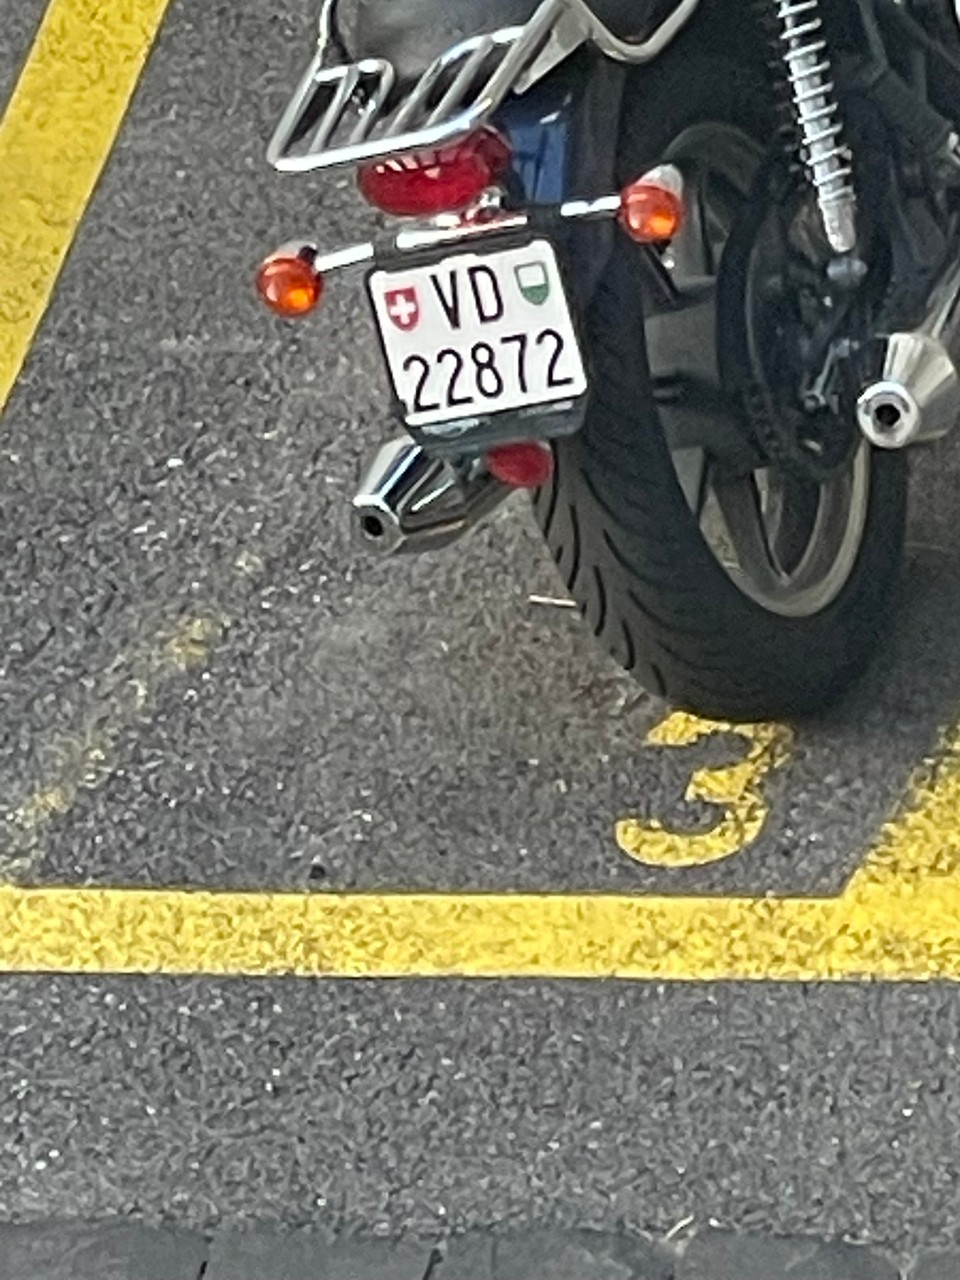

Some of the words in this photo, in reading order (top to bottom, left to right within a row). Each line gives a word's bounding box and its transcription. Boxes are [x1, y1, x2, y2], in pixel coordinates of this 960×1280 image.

[430, 264, 505, 330] VD
[402, 328, 575, 413] 22872
[616, 710, 794, 868] 3
